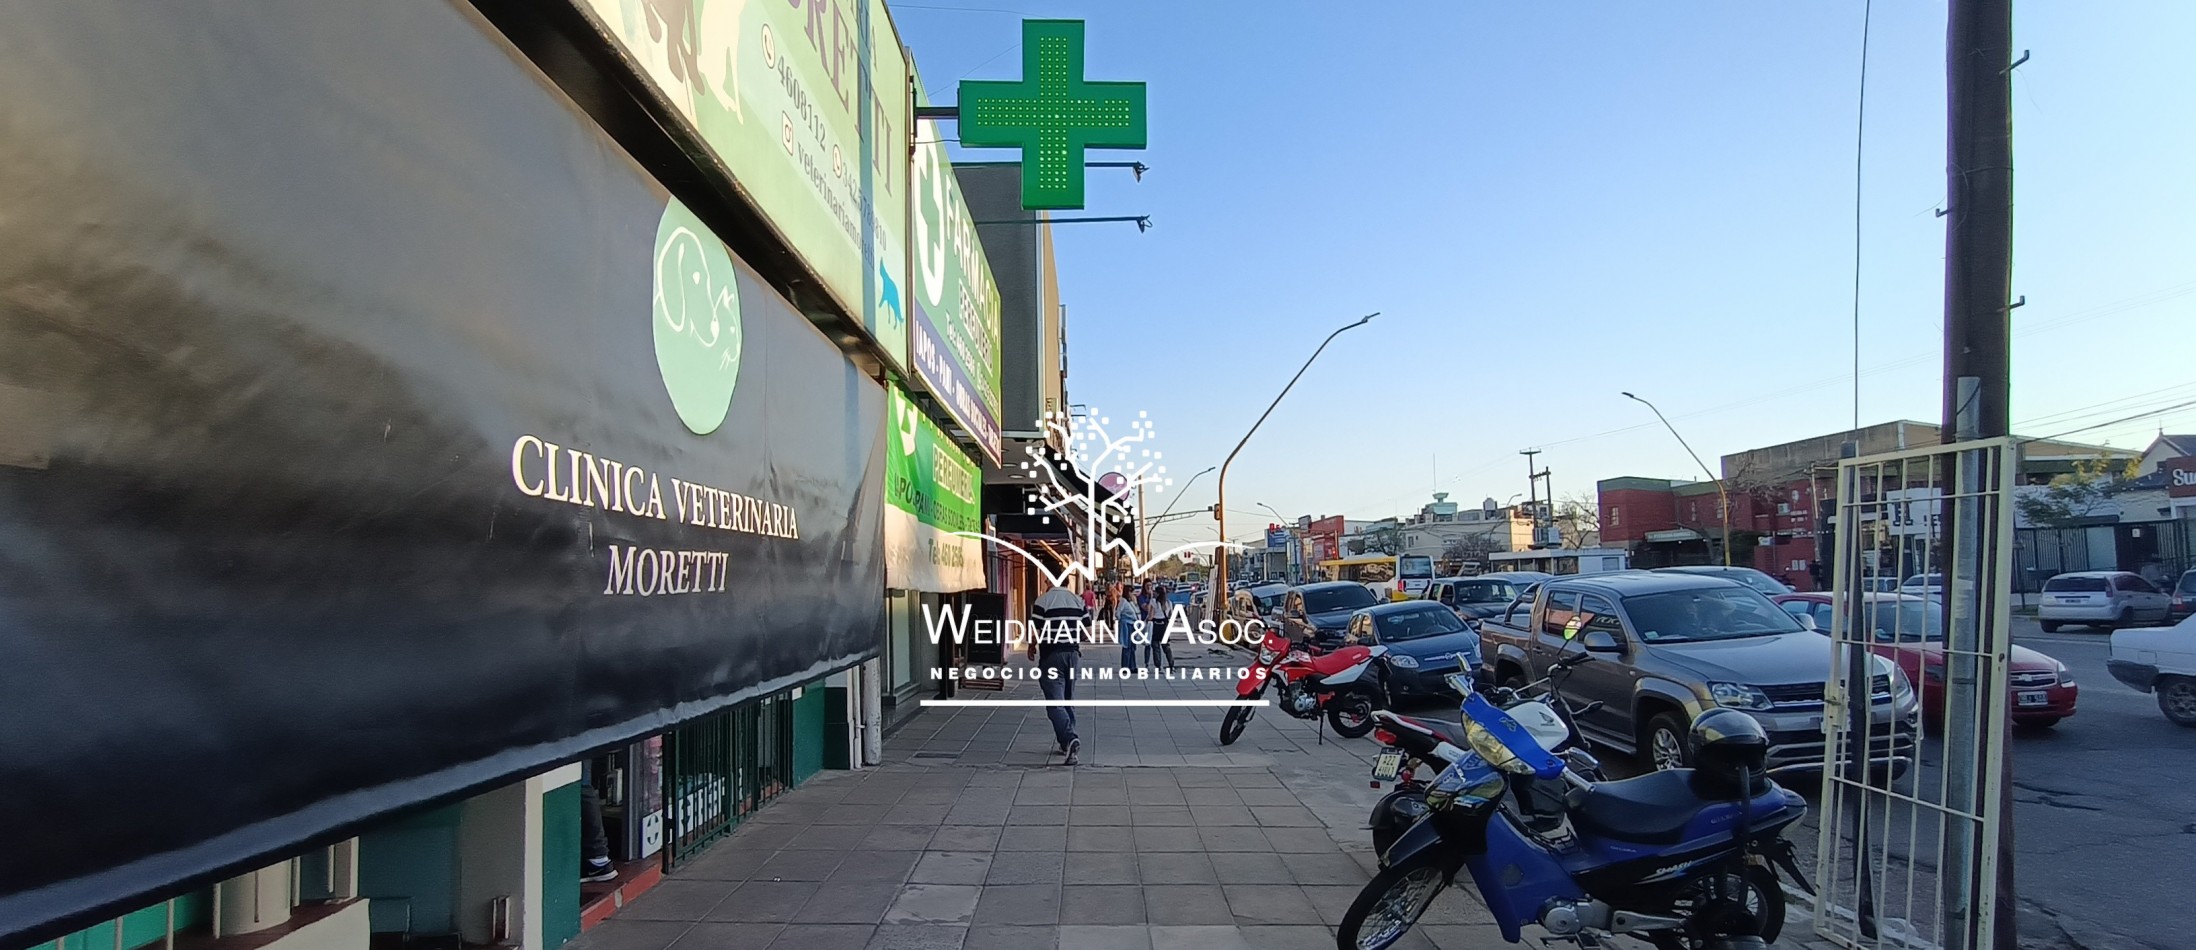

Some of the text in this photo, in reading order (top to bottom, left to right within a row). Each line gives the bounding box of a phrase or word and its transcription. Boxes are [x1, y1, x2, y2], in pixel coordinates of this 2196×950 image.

[778, 55, 825, 152] 4608112
[946, 174, 999, 351] FARMACIA
[916, 320, 936, 374] IAPOS
[512, 435, 799, 540] CLINICA VETERINARIA
[604, 544, 730, 597] MORETTI
